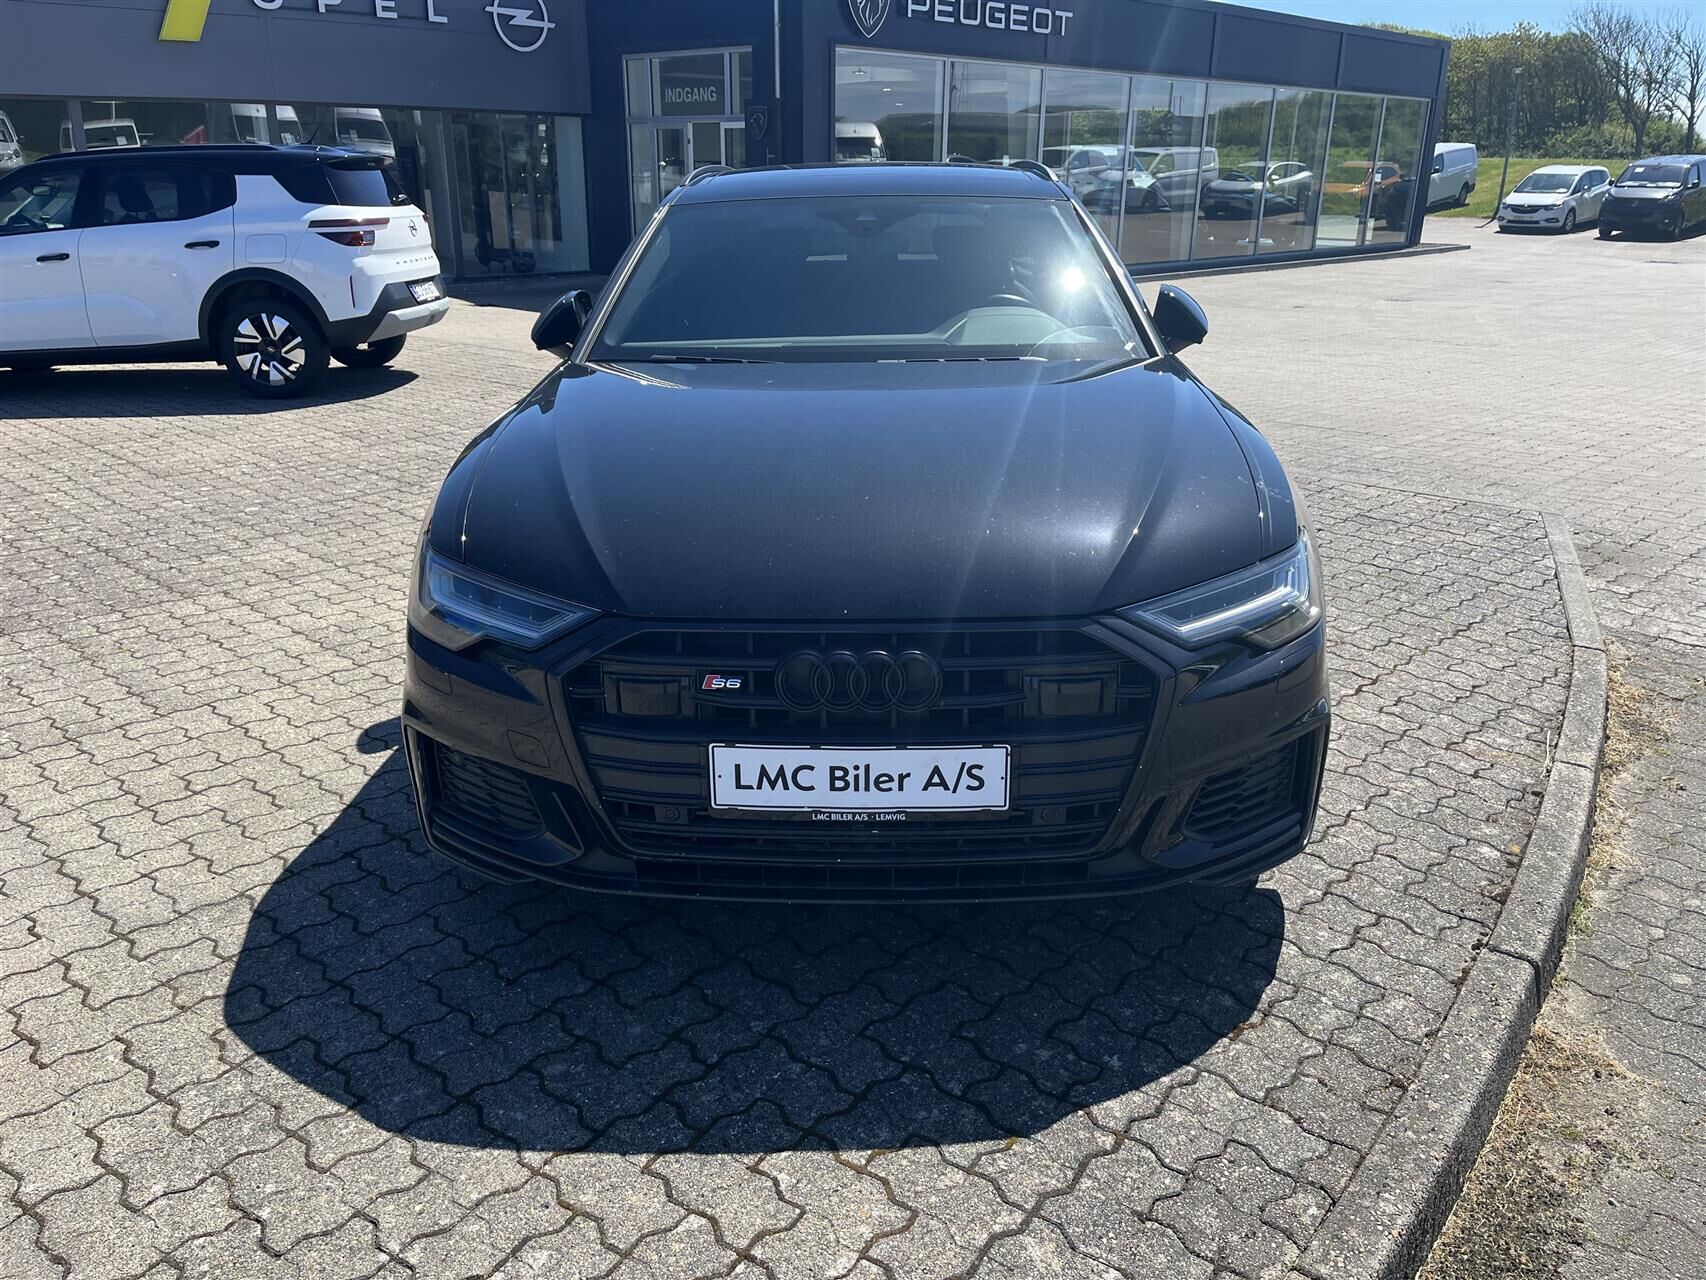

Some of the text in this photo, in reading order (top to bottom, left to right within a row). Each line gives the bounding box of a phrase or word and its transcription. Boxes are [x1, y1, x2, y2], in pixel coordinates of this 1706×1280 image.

[907, 0, 1073, 36] PEUGEOT
[665, 86, 717, 103] INDGANG
[711, 678, 742, 688] S6
[734, 761, 985, 794] LMC Biler A/S
[854, 813, 868, 821] A/S
[876, 813, 905, 821] LEMVIG
